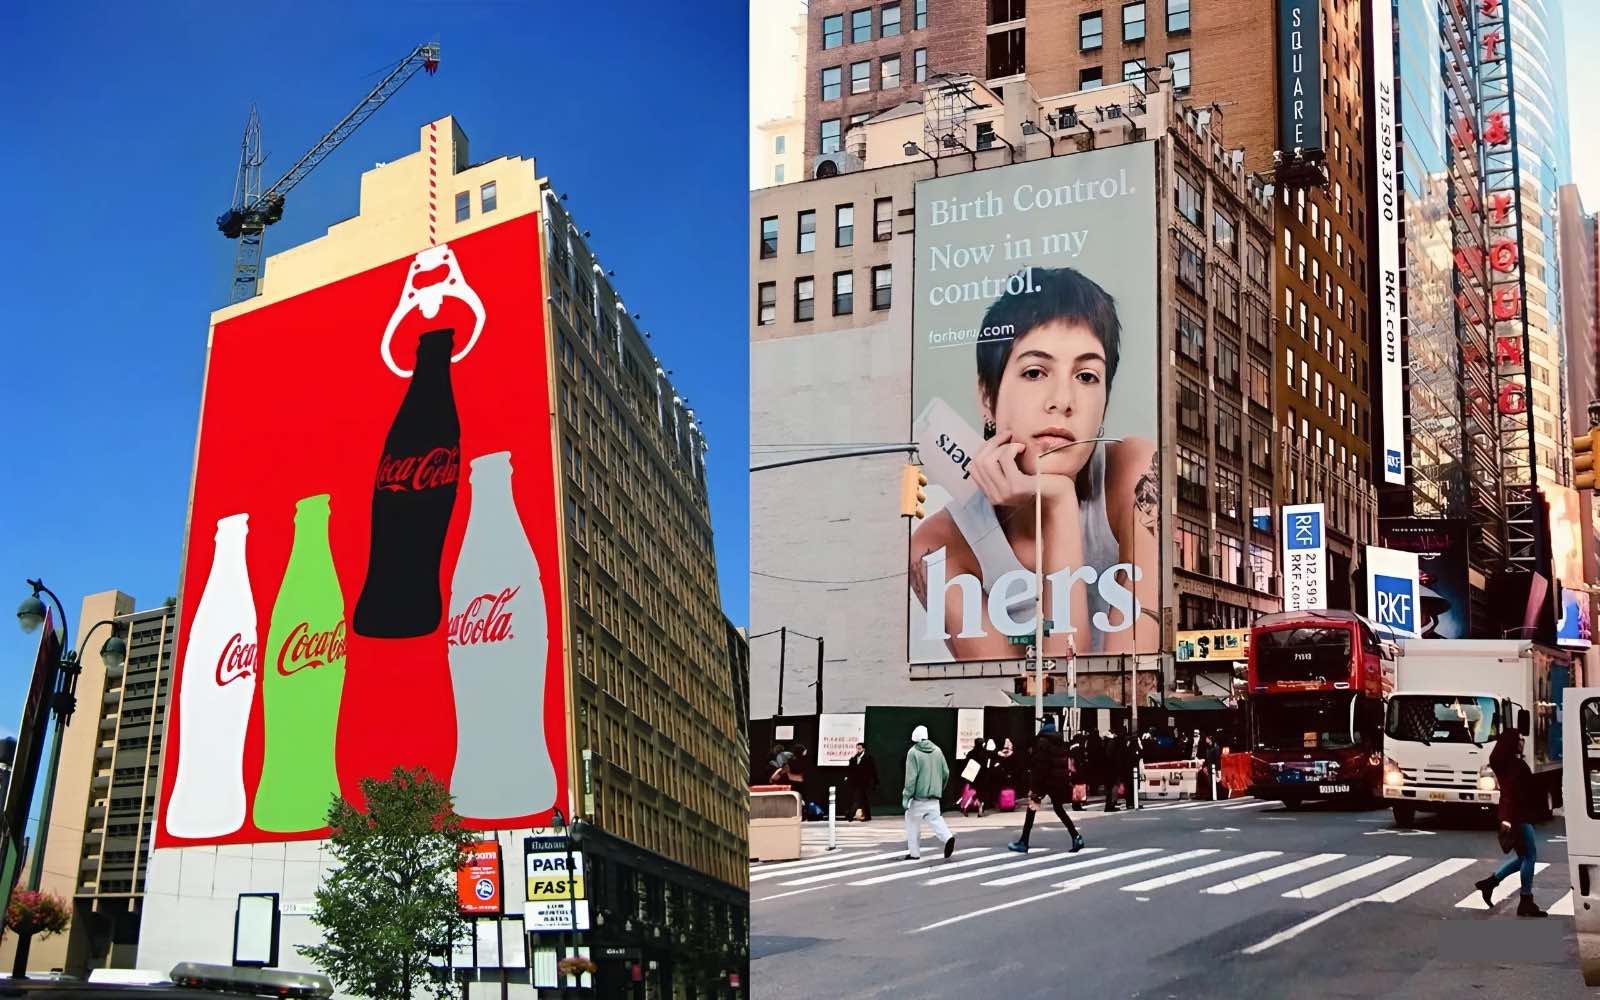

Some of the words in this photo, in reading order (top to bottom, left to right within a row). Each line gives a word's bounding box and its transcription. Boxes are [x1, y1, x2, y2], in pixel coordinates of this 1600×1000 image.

[1292, 8, 1303, 143] SQUARE
[1379, 81, 1394, 222] 212.599.3700
[929, 190, 1003, 227] Birth
[1013, 168, 1136, 212] Control.
[929, 243, 995, 272] Now
[1003, 233, 1032, 260] in
[1041, 229, 1088, 257] my
[929, 266, 1042, 306] control.
[1384, 270, 1395, 363] RKF.com
[1295, 515, 1313, 546] RKF
[921, 545, 1142, 640] hers
[1377, 591, 1411, 627] RKF
